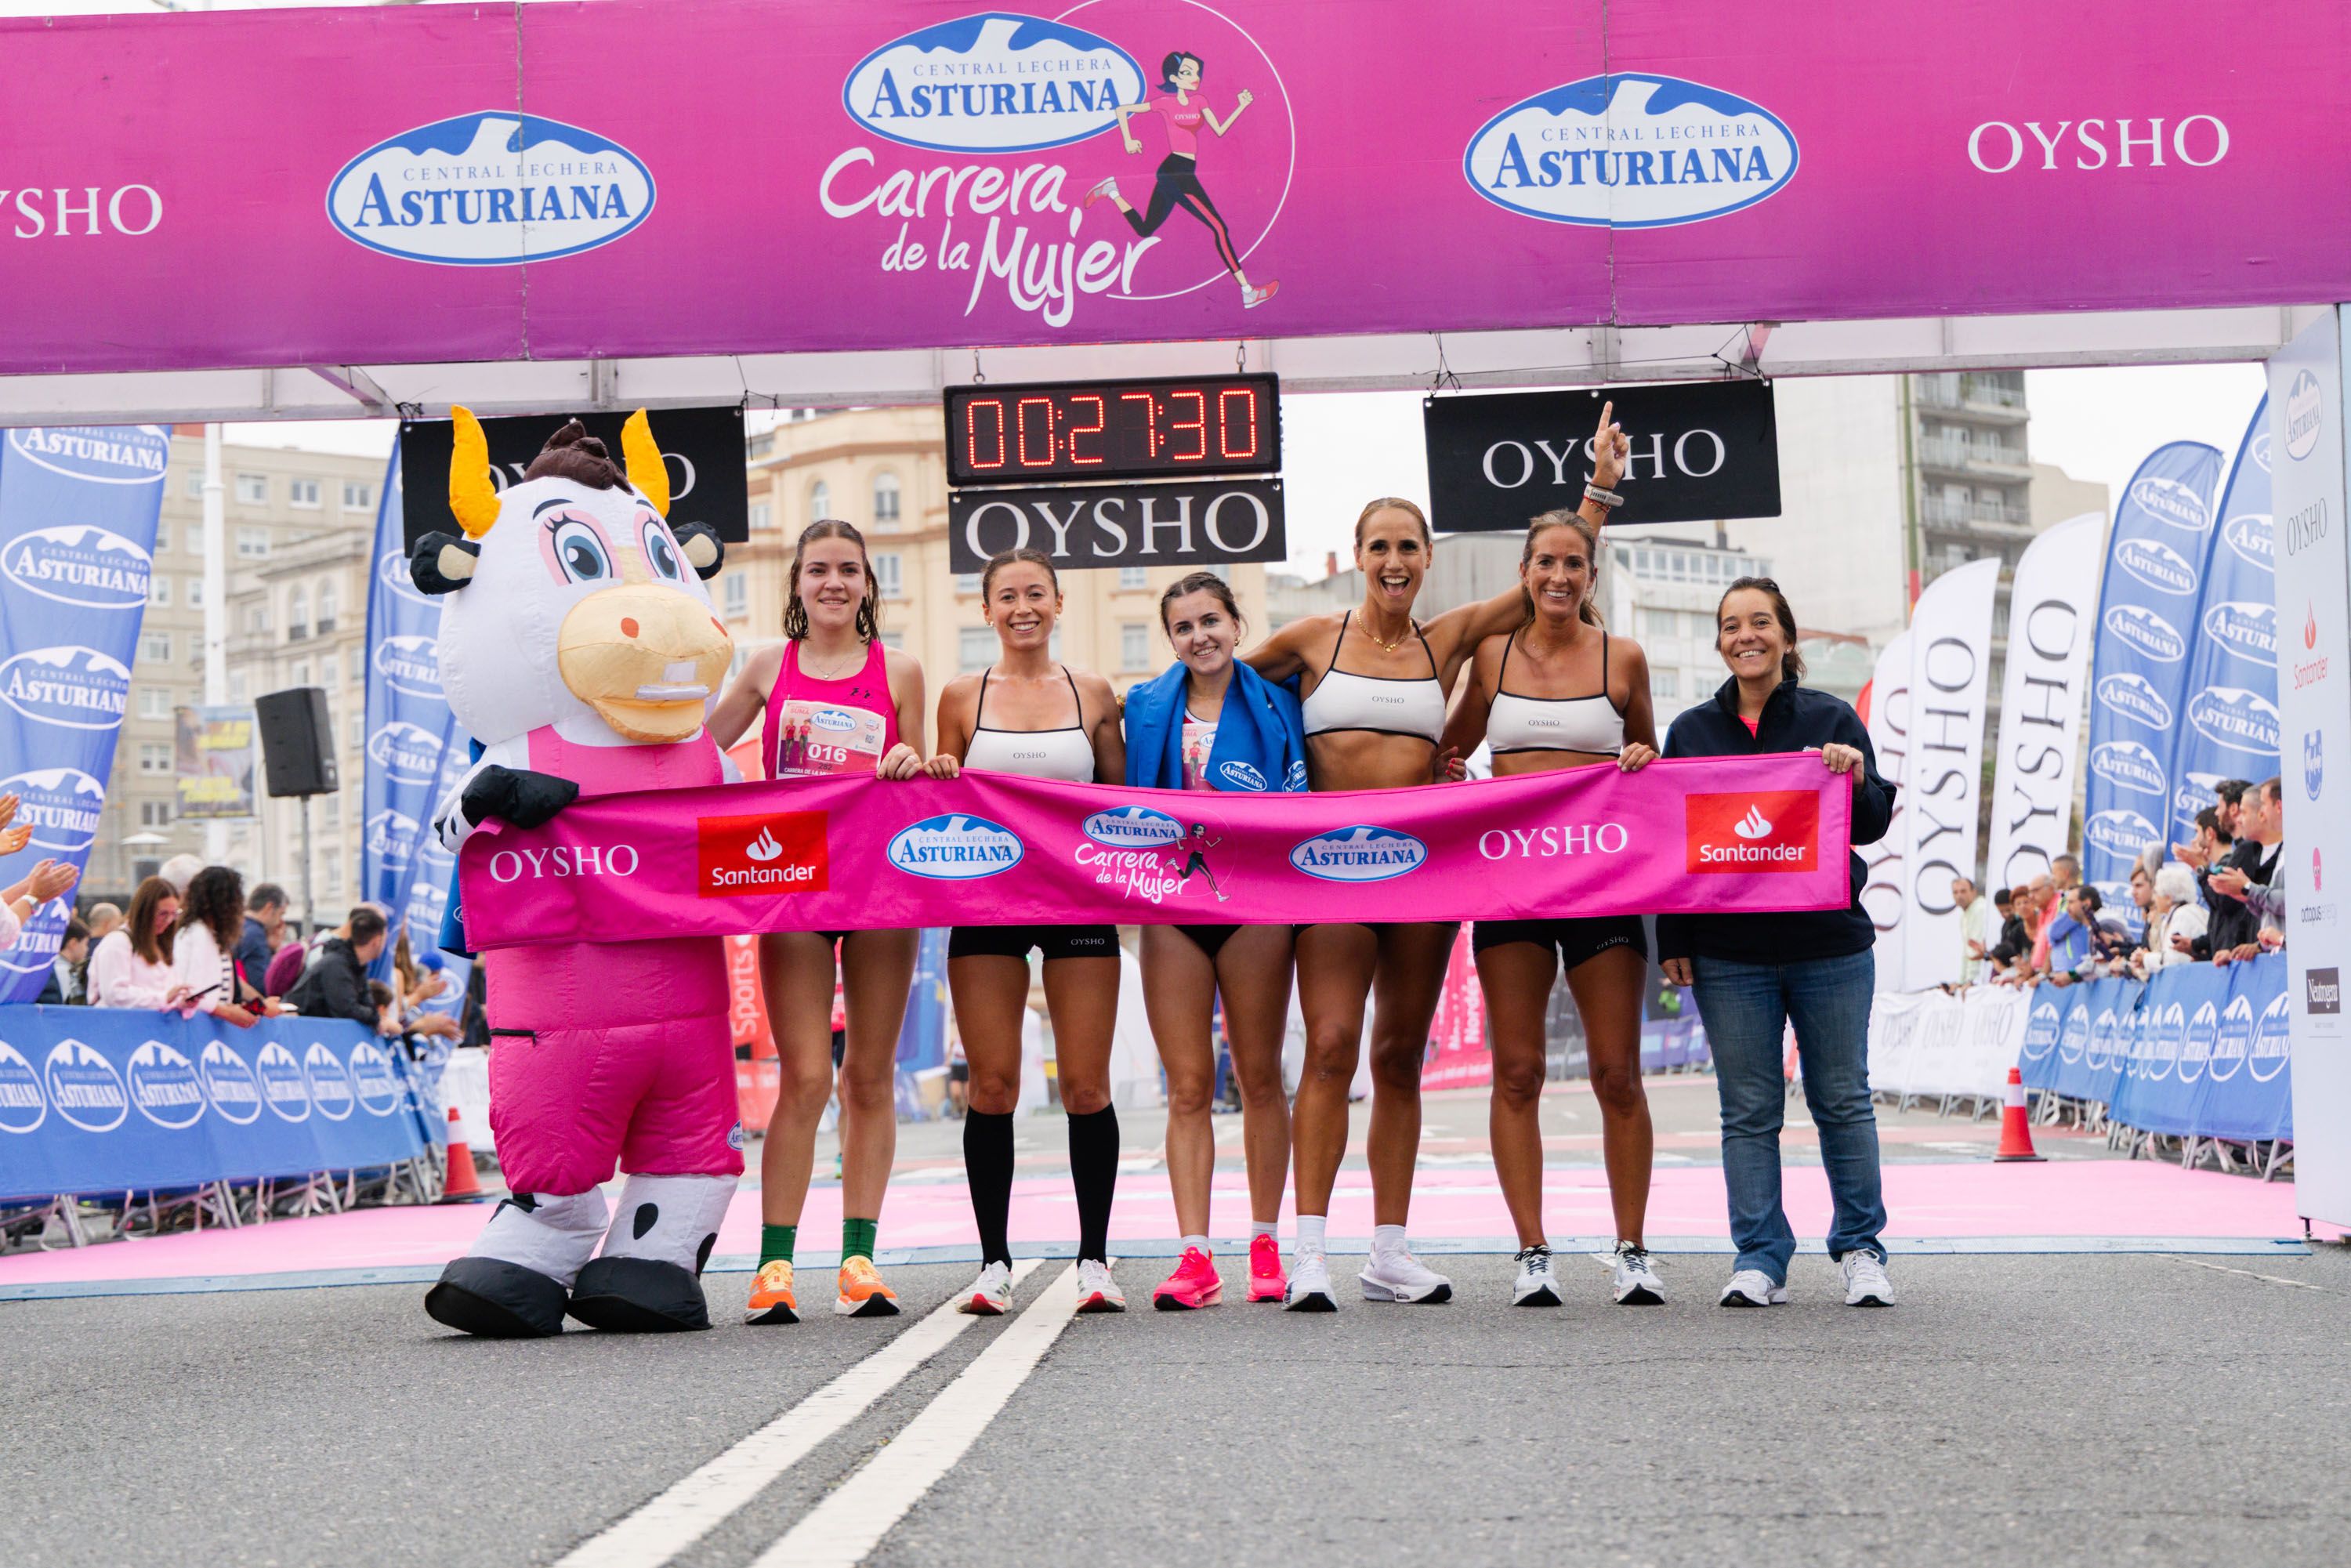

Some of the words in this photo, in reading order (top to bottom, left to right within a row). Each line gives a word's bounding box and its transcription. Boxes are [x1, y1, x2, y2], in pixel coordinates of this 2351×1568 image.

[914, 61, 1009, 77] CENTRAL
[1017, 58, 1113, 74] LECHERA
[868, 68, 1121, 119] ASTURIANA
[1541, 127, 1643, 143] CENTRAL
[1655, 123, 1761, 139] LECHERA
[1968, 114, 2230, 173] OYSHO
[403, 165, 505, 181] CENTRAL
[520, 161, 619, 177] LECHERA
[1491, 132, 1773, 189] ASTURIANA
[353, 172, 630, 227] ASTURIANA
[819, 147, 1067, 219] Carrera
[0, 183, 163, 239] SHO
[881, 223, 928, 272] de
[937, 219, 971, 270] la
[964, 206, 1162, 328] Mujer
[968, 389, 1256, 469] 00:27:30
[2286, 403, 2320, 445] ASTURIANA
[23, 428, 164, 471] ASTURIANA
[965, 491, 1270, 563] OYSHO
[2287, 498, 2327, 556] OYSHO
[13, 545, 149, 596] ASTURIANA
[2122, 545, 2191, 590] ASTURIANA
[2112, 612, 2178, 657] ASTURIANA
[7, 667, 128, 715] ASTURIAN
[2295, 656, 2328, 690] Santander
[1371, 695, 1405, 704] OYSHO
[813, 715, 853, 729] ASTURIANA
[1528, 719, 1561, 727] OYSHO
[2197, 707, 2280, 747] ASTURIAN
[808, 743, 847, 762] 016
[818, 762, 832, 771] 282
[1223, 763, 1263, 790] ASTURIANA
[1915, 637, 1976, 916] OYSHO
[1092, 818, 1177, 838] ASTURIANA
[1478, 822, 1628, 860] OYSHO
[489, 844, 639, 883] OYSHO
[899, 838, 1014, 863] ASTURIANA
[1074, 842, 1160, 870] Carrera
[1300, 846, 1417, 866] ASTURIANA
[1700, 842, 1806, 864] Santander
[712, 862, 816, 887] Santander
[1096, 867, 1112, 883] de
[1115, 867, 1127, 884] la
[1123, 866, 1190, 904] Mujer
[1070, 937, 1106, 946] OYSHO
[731, 948, 762, 1037] Sports
[2308, 979, 2338, 1009] Neutrogena
